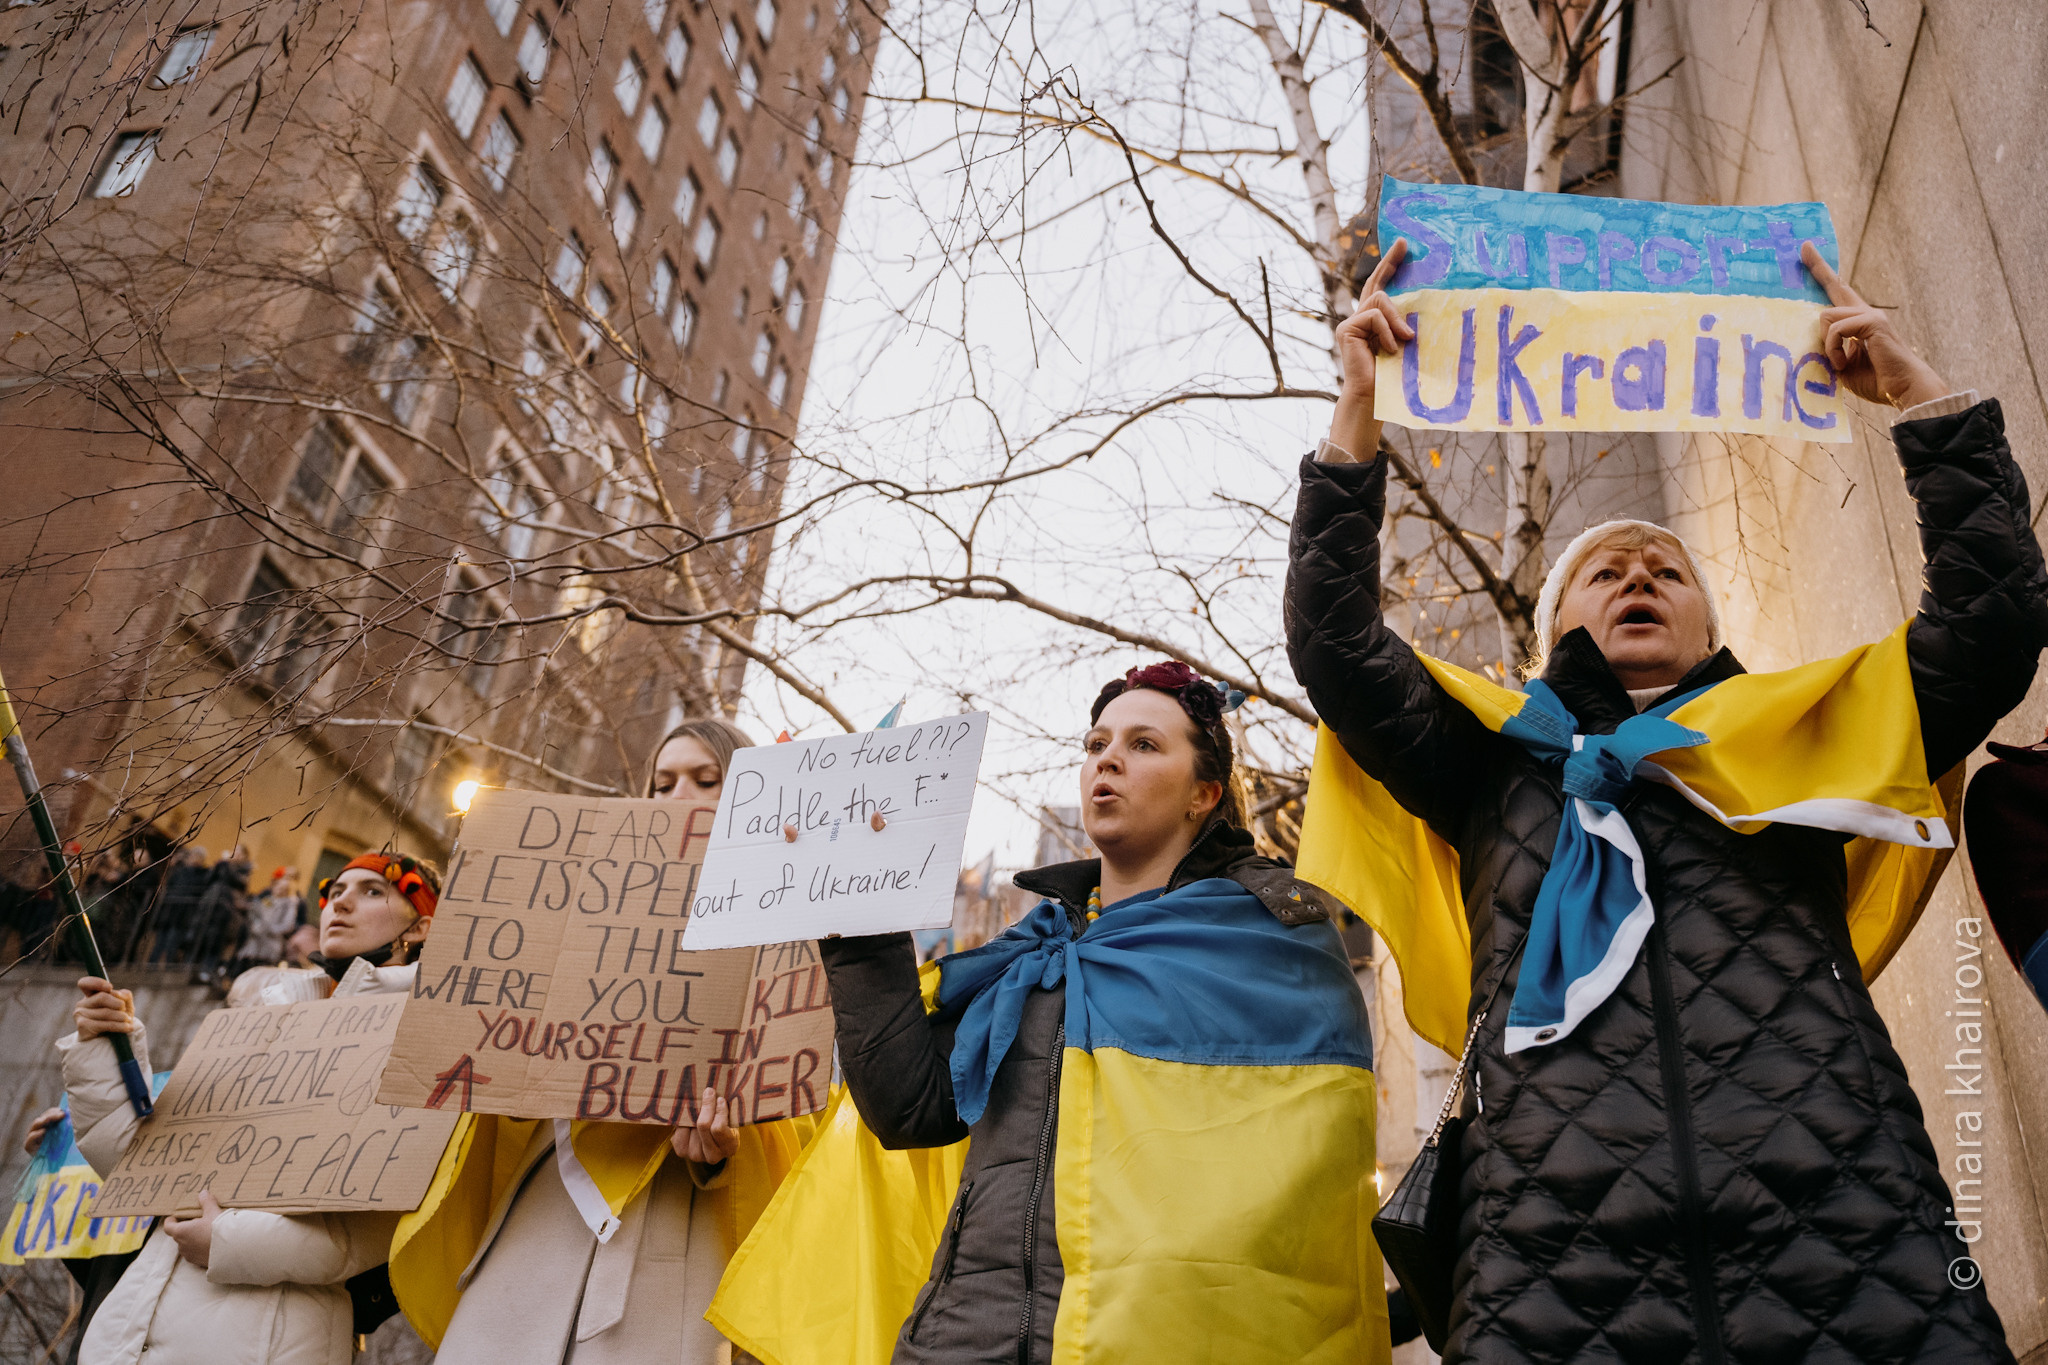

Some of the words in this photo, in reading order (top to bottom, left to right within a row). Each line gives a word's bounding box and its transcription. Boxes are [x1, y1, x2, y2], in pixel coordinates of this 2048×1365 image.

[1384, 192, 1828, 290] Support
[1402, 305, 1838, 430] Ukraine
[797, 738, 836, 774] No
[518, 806, 672, 860] DEAR
[678, 806, 717, 860] P
[727, 770, 831, 839] Paddle
[842, 783, 902, 824] the
[693, 878, 743, 919] out
[758, 862, 796, 910] of
[808, 843, 937, 903] Ukraine!
[454, 913, 525, 962] TO
[587, 924, 705, 977] THE
[203, 1009, 309, 1050] PLEASE
[315, 1002, 398, 1040] PRAY
[413, 962, 552, 1011] WHERE
[580, 977, 706, 1027] YOU
[476, 1008, 700, 1064] YOURSELF
[707, 1023, 769, 1065] IN
[172, 1044, 360, 1117] UKRAINE
[423, 1053, 492, 1113] A
[576, 1046, 822, 1128] BUNKER
[115, 1132, 212, 1172] PLEASE
[231, 1125, 420, 1203] PEACE
[94, 1172, 168, 1213] PRAY
[170, 1170, 218, 1195] FOR
